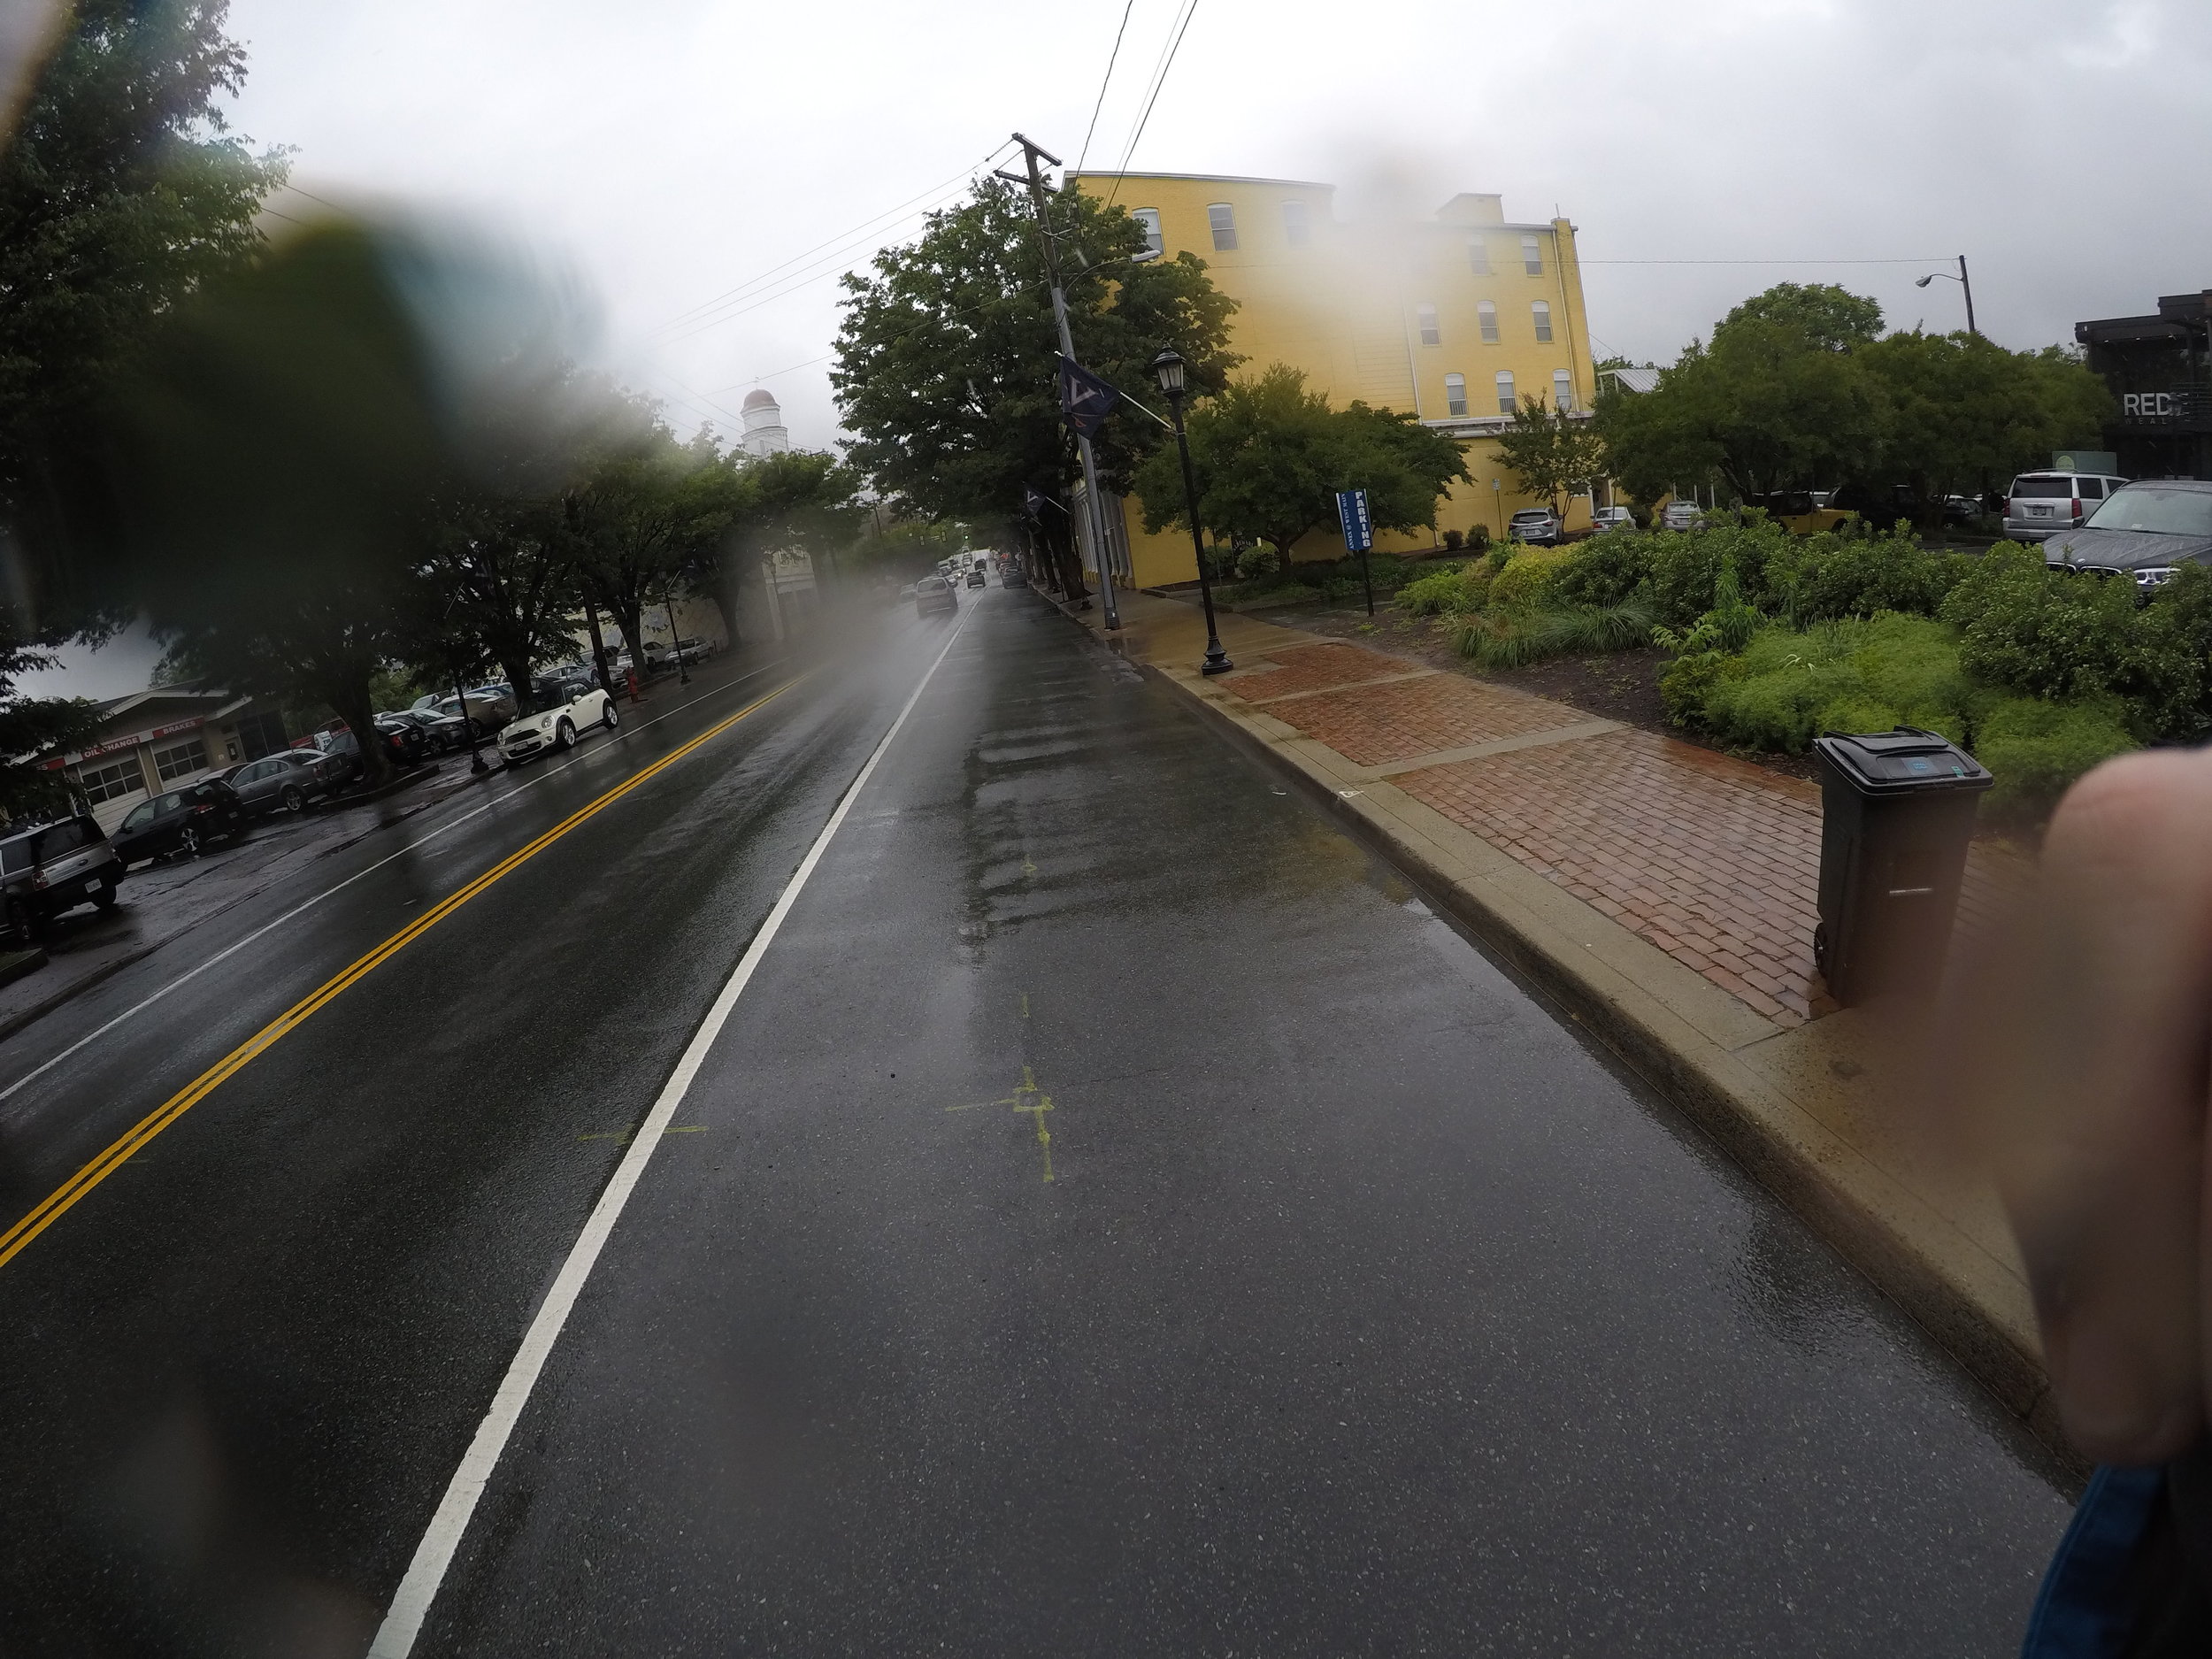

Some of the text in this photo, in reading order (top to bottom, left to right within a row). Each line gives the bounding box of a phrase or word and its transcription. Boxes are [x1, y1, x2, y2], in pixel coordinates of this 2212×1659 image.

[1355, 491, 1371, 547] PARKING
[163, 720, 196, 734] BRAKES
[84, 736, 139, 757] OIL CHANGE
